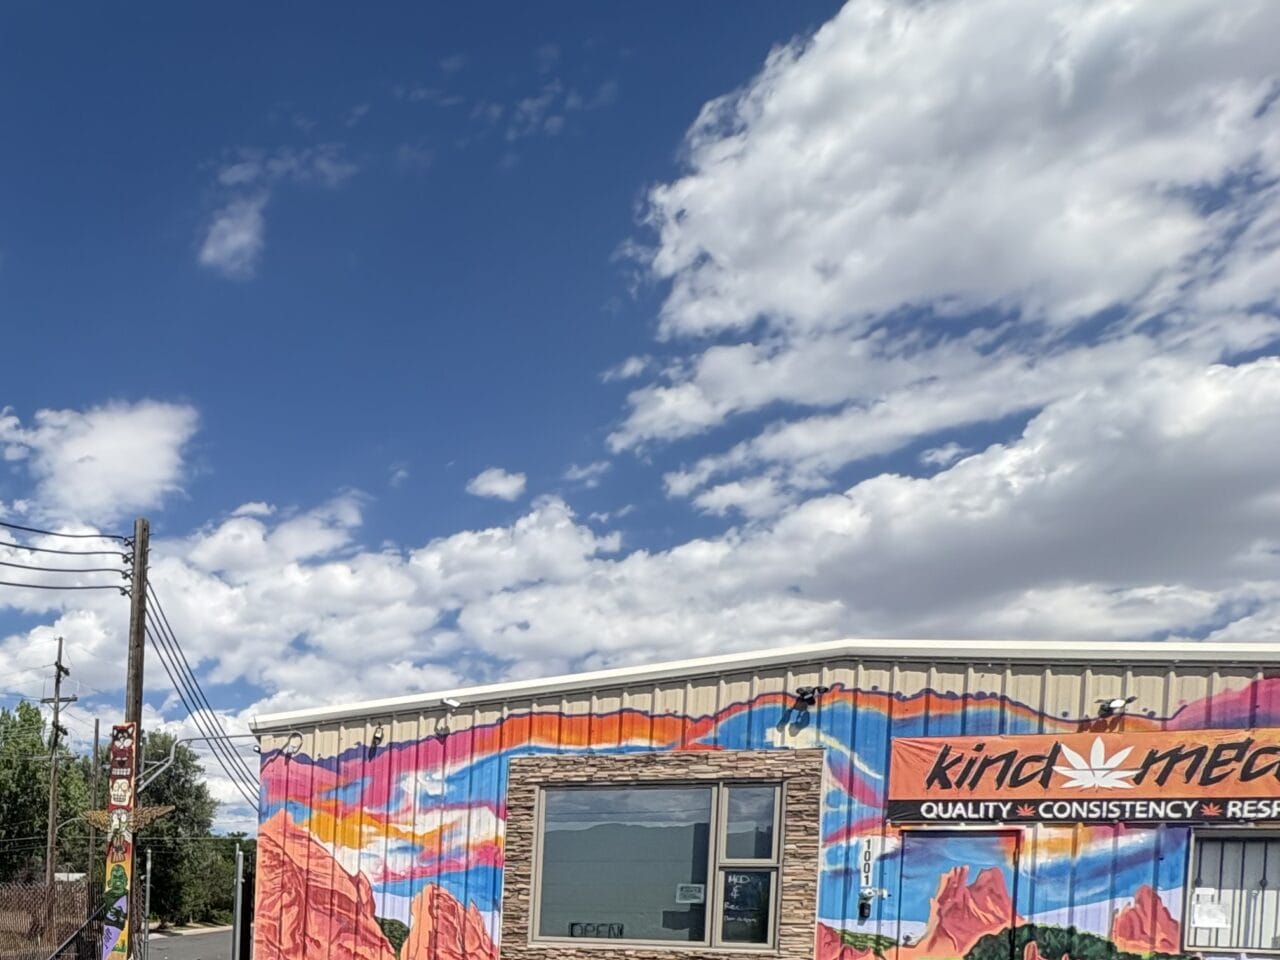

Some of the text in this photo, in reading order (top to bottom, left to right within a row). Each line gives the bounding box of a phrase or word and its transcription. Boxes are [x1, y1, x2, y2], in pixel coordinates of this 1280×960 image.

[925, 740, 1063, 791] kind
[920, 801, 1013, 820] QUALITY
[1038, 801, 1198, 819] CONSISTENCY
[863, 838, 872, 886] 1001
[570, 923, 624, 939] OPEN
